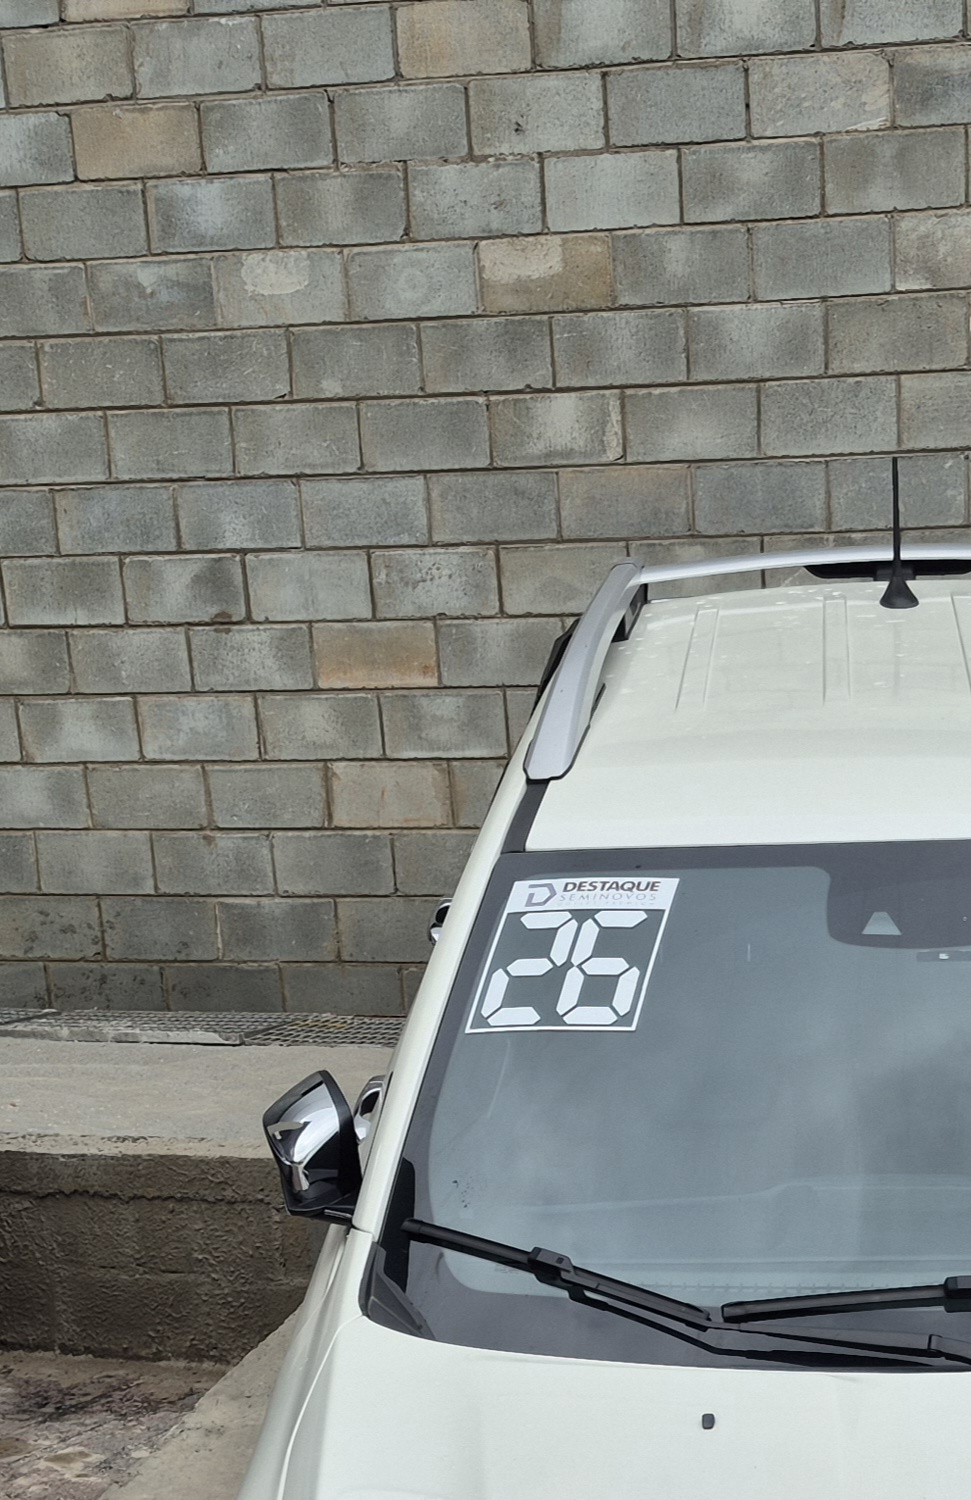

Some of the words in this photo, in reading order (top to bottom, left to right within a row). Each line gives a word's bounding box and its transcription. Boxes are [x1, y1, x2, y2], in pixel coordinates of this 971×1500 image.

[562, 880, 661, 892] DESTAQUE
[559, 893, 657, 901] SEMINOVOS
[481, 910, 648, 1026] 26
